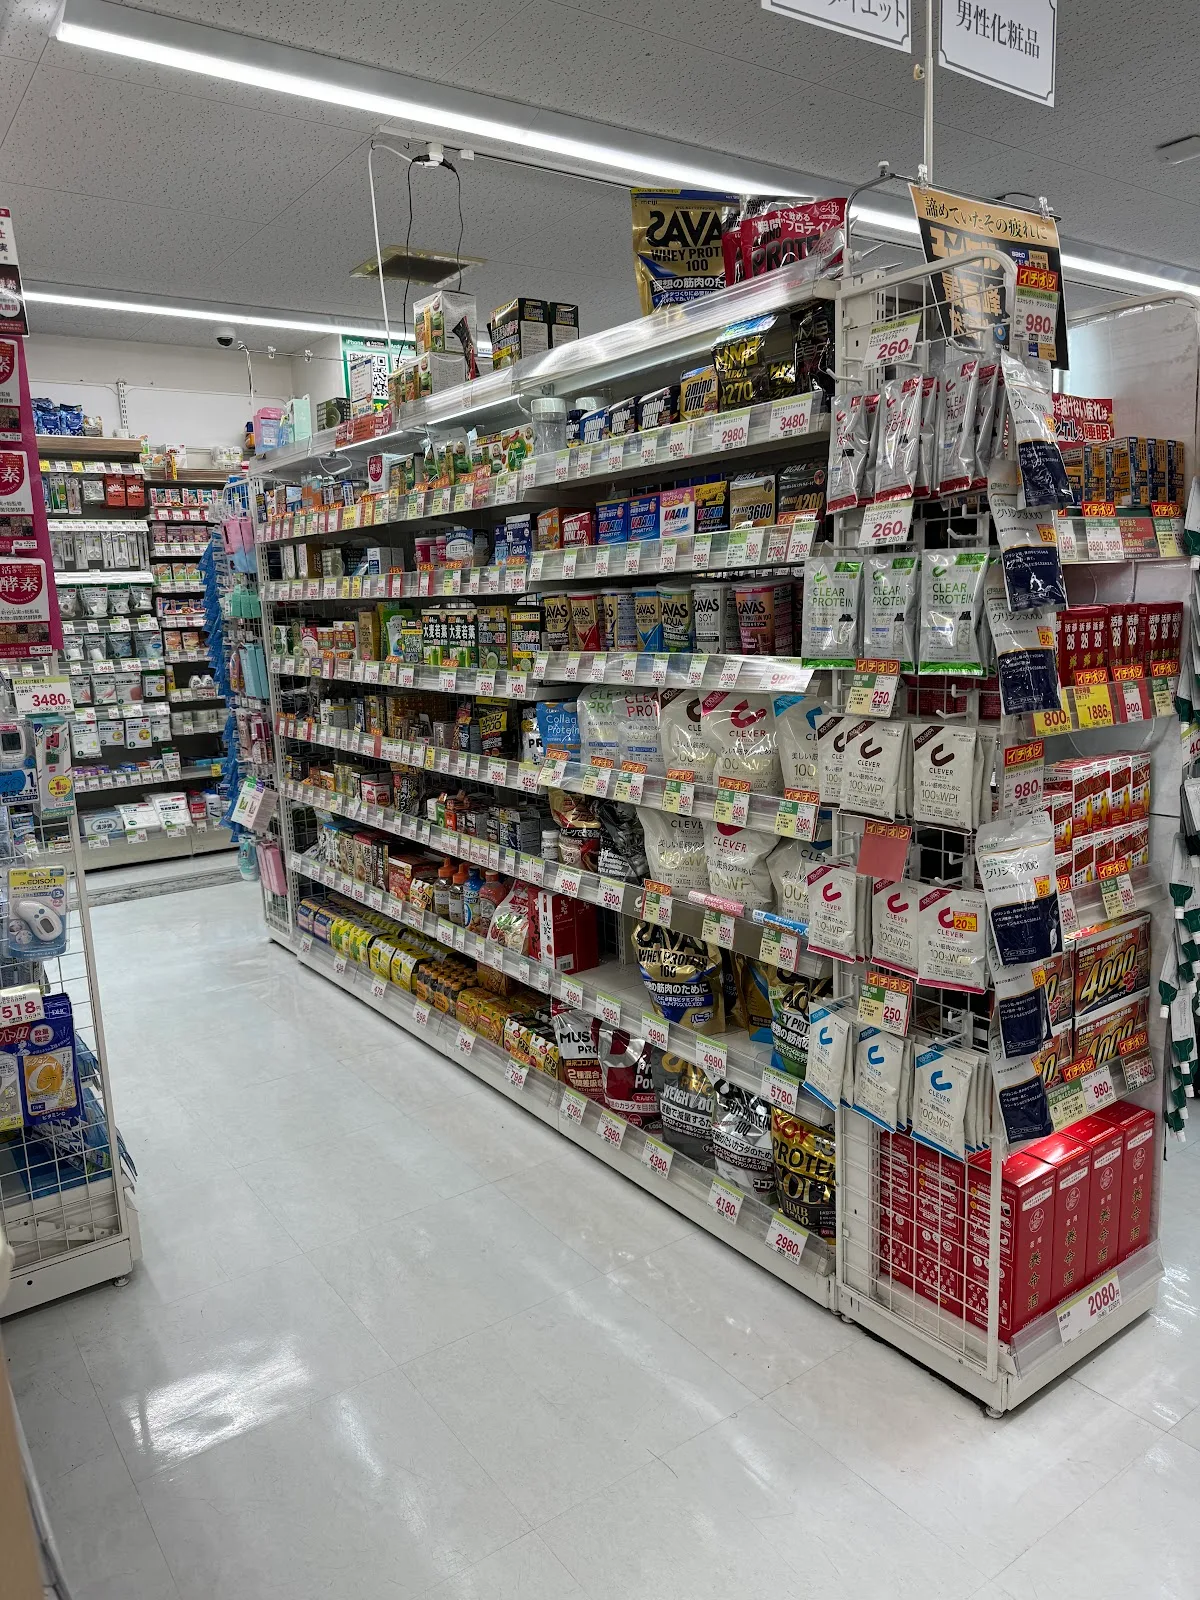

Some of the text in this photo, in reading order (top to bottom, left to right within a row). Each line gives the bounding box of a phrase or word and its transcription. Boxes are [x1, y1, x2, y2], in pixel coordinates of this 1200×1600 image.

[828, 0, 905, 27] エット
[956, 1, 1041, 59] 男性化粧品
[924, 197, 1049, 241] 諦めていたその疲れに
[651, 245, 723, 262] WHEY PROT
[685, 261, 709, 272] 100
[1020, 271, 1057, 292] イチオシ
[642, 398, 664, 415] amino
[584, 416, 605, 428] amino
[642, 414, 659, 428] VITAL
[584, 430, 600, 444] VITAL
[664, 507, 688, 521] VAAM
[747, 504, 773, 519] 3600
[1084, 503, 1114, 516] イチオシ
[812, 587, 844, 597] CLEAR
[873, 586, 901, 596] CLEAR
[932, 582, 966, 593] CLEAR
[812, 597, 853, 607] PROTEIN
[872, 596, 906, 606] PROTEIN
[932, 594, 974, 605] PROTEIN
[698, 613, 713, 622] SOY
[423, 624, 448, 639] 大麦若葉
[449, 624, 476, 639] 大麦若葉
[858, 660, 898, 673] イチオシ
[1114, 665, 1143, 680] イチオシ
[1152, 662, 1178, 676] イチオシ
[1077, 670, 1107, 684] イチオシ
[872, 691, 890, 705] 250
[729, 730, 766, 738] CLEVER
[1007, 743, 1043, 765] イチオシ
[857, 760, 881, 768] CLEVER
[667, 770, 694, 782] イチオシ
[928, 767, 954, 776] CLEVER
[720, 777, 750, 792] イチオシ
[785, 789, 819, 804] イチオシ
[921, 789, 958, 804] 100%WPI
[866, 821, 911, 839] イチオシ
[714, 836, 747, 853] CLEVER
[1099, 861, 1128, 879] イチオシ
[820, 901, 842, 911] CLEVER
[886, 913, 909, 924] CLEVER
[956, 920, 967, 928] 20
[937, 929, 964, 939] CLEVER
[639, 949, 662, 963] WHEY
[660, 965, 677, 978] 100
[1080, 944, 1138, 1003] 4000
[868, 974, 911, 993] イチオシ
[883, 1005, 901, 1021] 250
[559, 1031, 593, 1044] MUS
[1121, 1034, 1147, 1053] イチオシ
[1064, 1058, 1094, 1081] イチオシ
[928, 1088, 951, 1104] CLEVER
[735, 1121, 752, 1137] 100
